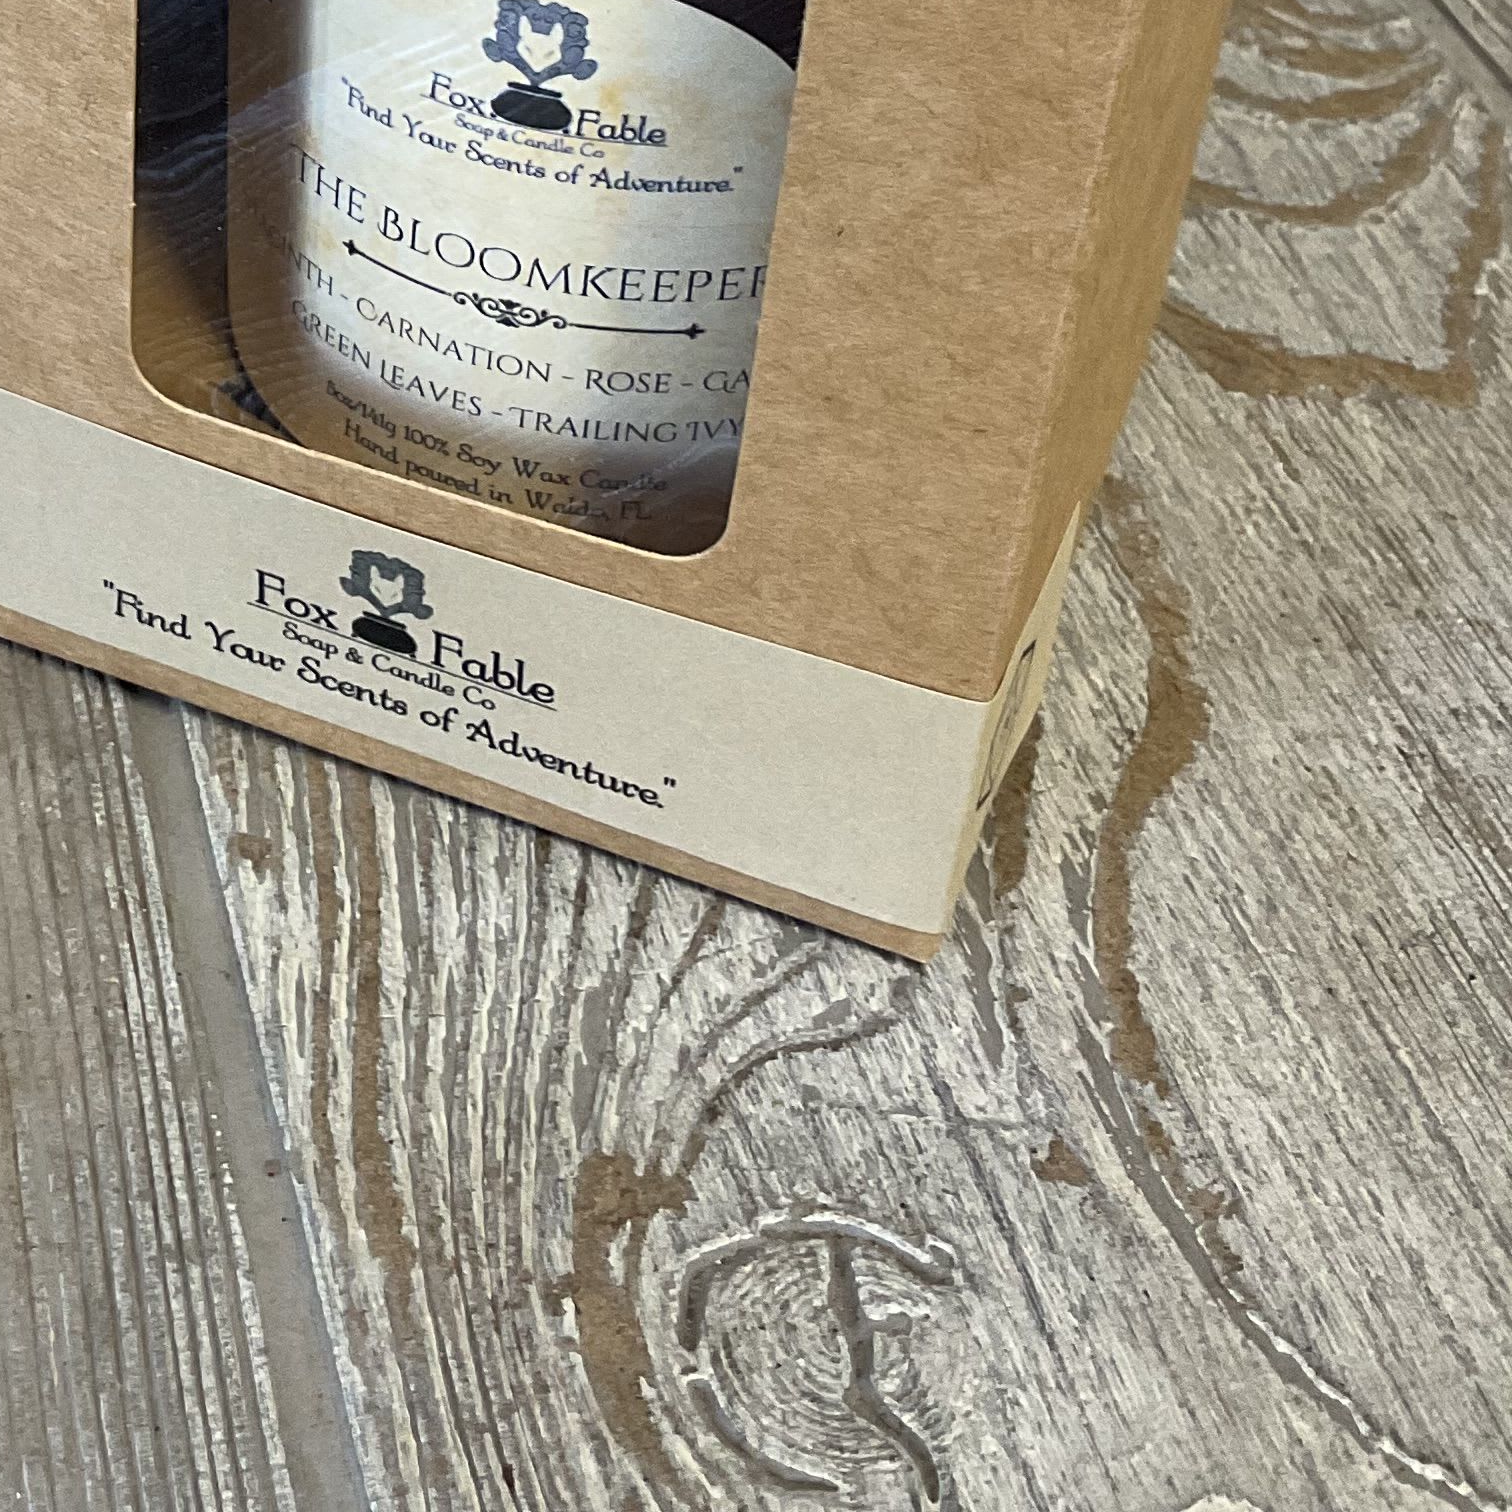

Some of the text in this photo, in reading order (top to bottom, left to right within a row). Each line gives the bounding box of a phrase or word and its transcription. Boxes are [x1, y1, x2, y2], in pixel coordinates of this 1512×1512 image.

[429, 71, 667, 144] Fox Fable
[454, 113, 493, 139] Soap
[511, 129, 573, 155] Candle
[579, 143, 605, 158] Co
[290, 143, 367, 224] THE
[465, 140, 546, 179] Scents
[555, 164, 584, 185] of
[292, 300, 371, 370] GREEN
[380, 359, 482, 416] LEAVES
[508, 406, 678, 443] TRAILING
[356, 297, 554, 383] CARNATION
[586, 368, 671, 396] ROSE
[344, 417, 400, 464] Hand
[405, 459, 481, 496] poured
[489, 484, 514, 505] in
[403, 425, 450, 456] 100%
[456, 443, 502, 476] Soy
[512, 456, 571, 486] Wax
[204, 620, 286, 673] Your
[296, 655, 409, 717] Scents
[420, 706, 459, 732] of
[255, 568, 555, 704] Fox Fable
[282, 621, 497, 710] Soap & Candle Co
